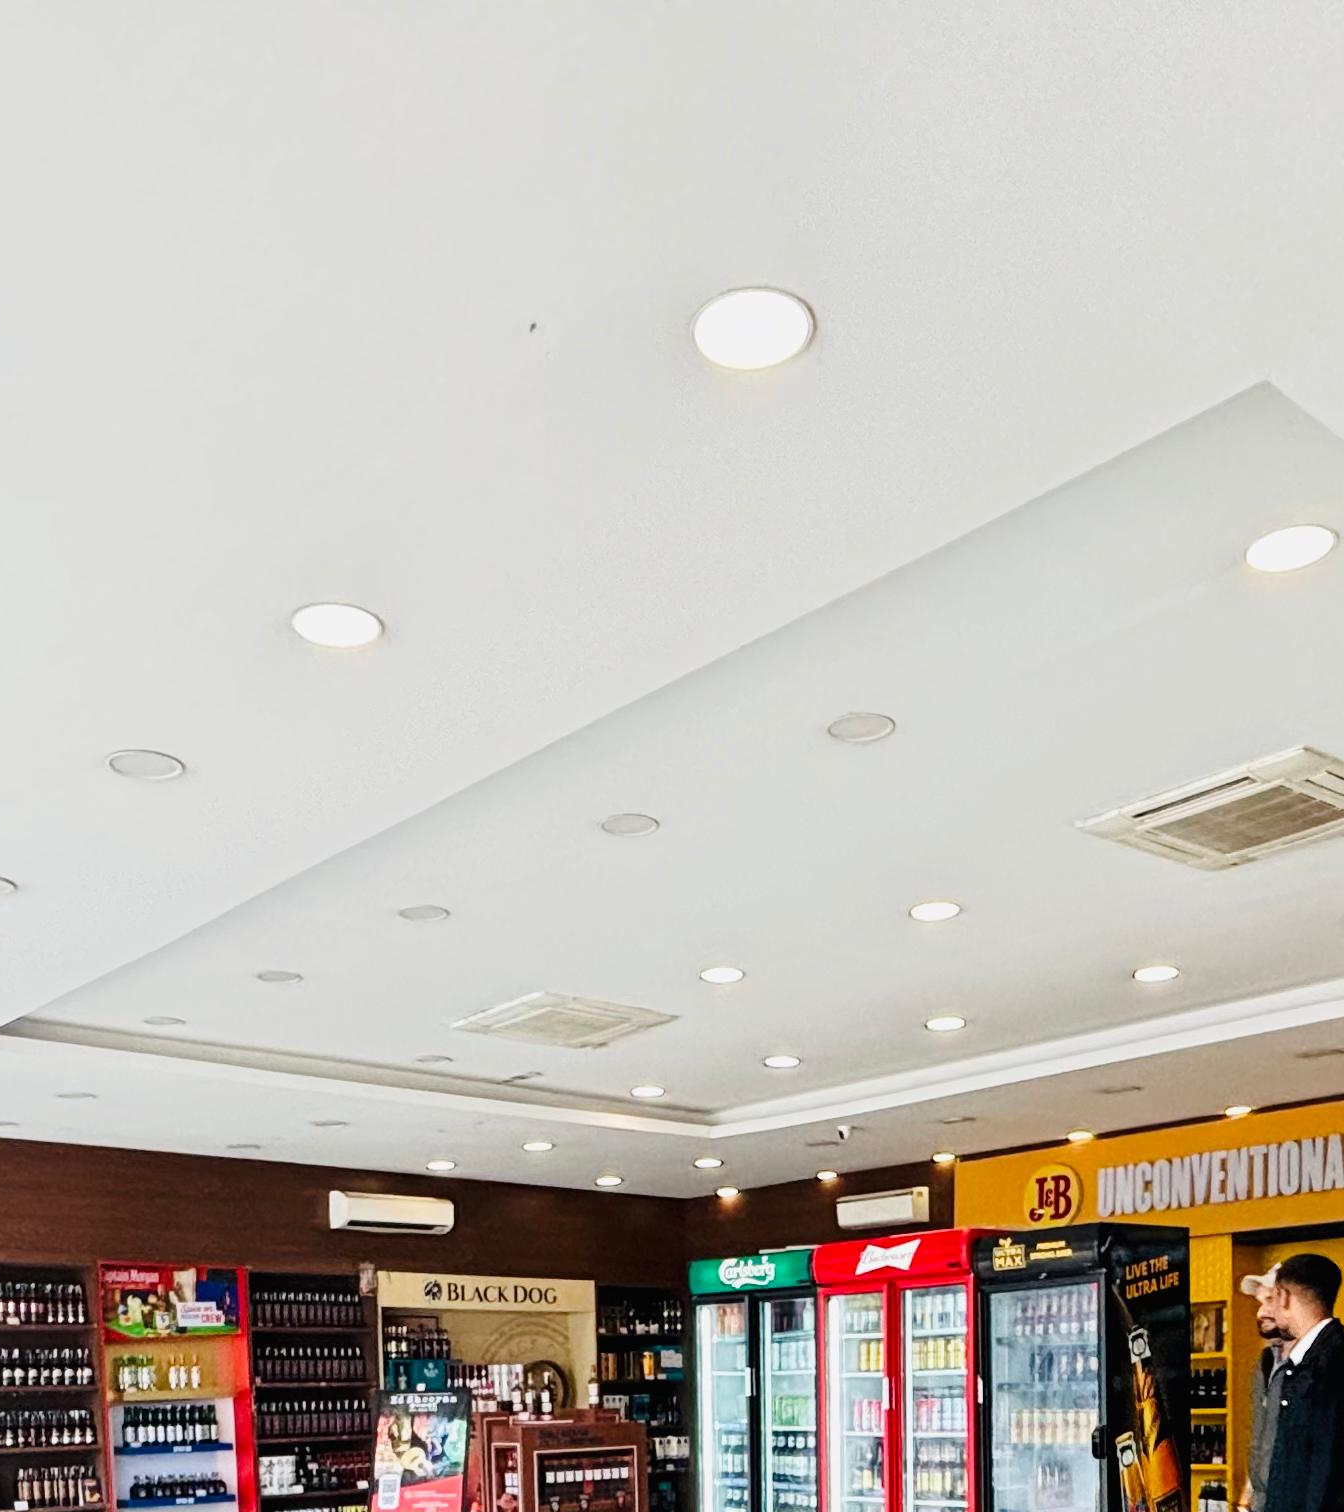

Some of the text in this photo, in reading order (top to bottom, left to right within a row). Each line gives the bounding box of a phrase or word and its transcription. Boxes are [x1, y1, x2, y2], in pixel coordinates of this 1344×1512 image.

[1029, 1173, 1072, 1222] J&B
[719, 1256, 775, 1288] Carlsberg
[995, 1256, 1022, 1267] MAX
[1126, 1255, 1168, 1280] LIVE THE
[447, 1282, 557, 1304] BLACK DOG
[1126, 1272, 1179, 1299] ULTRA LIFE
